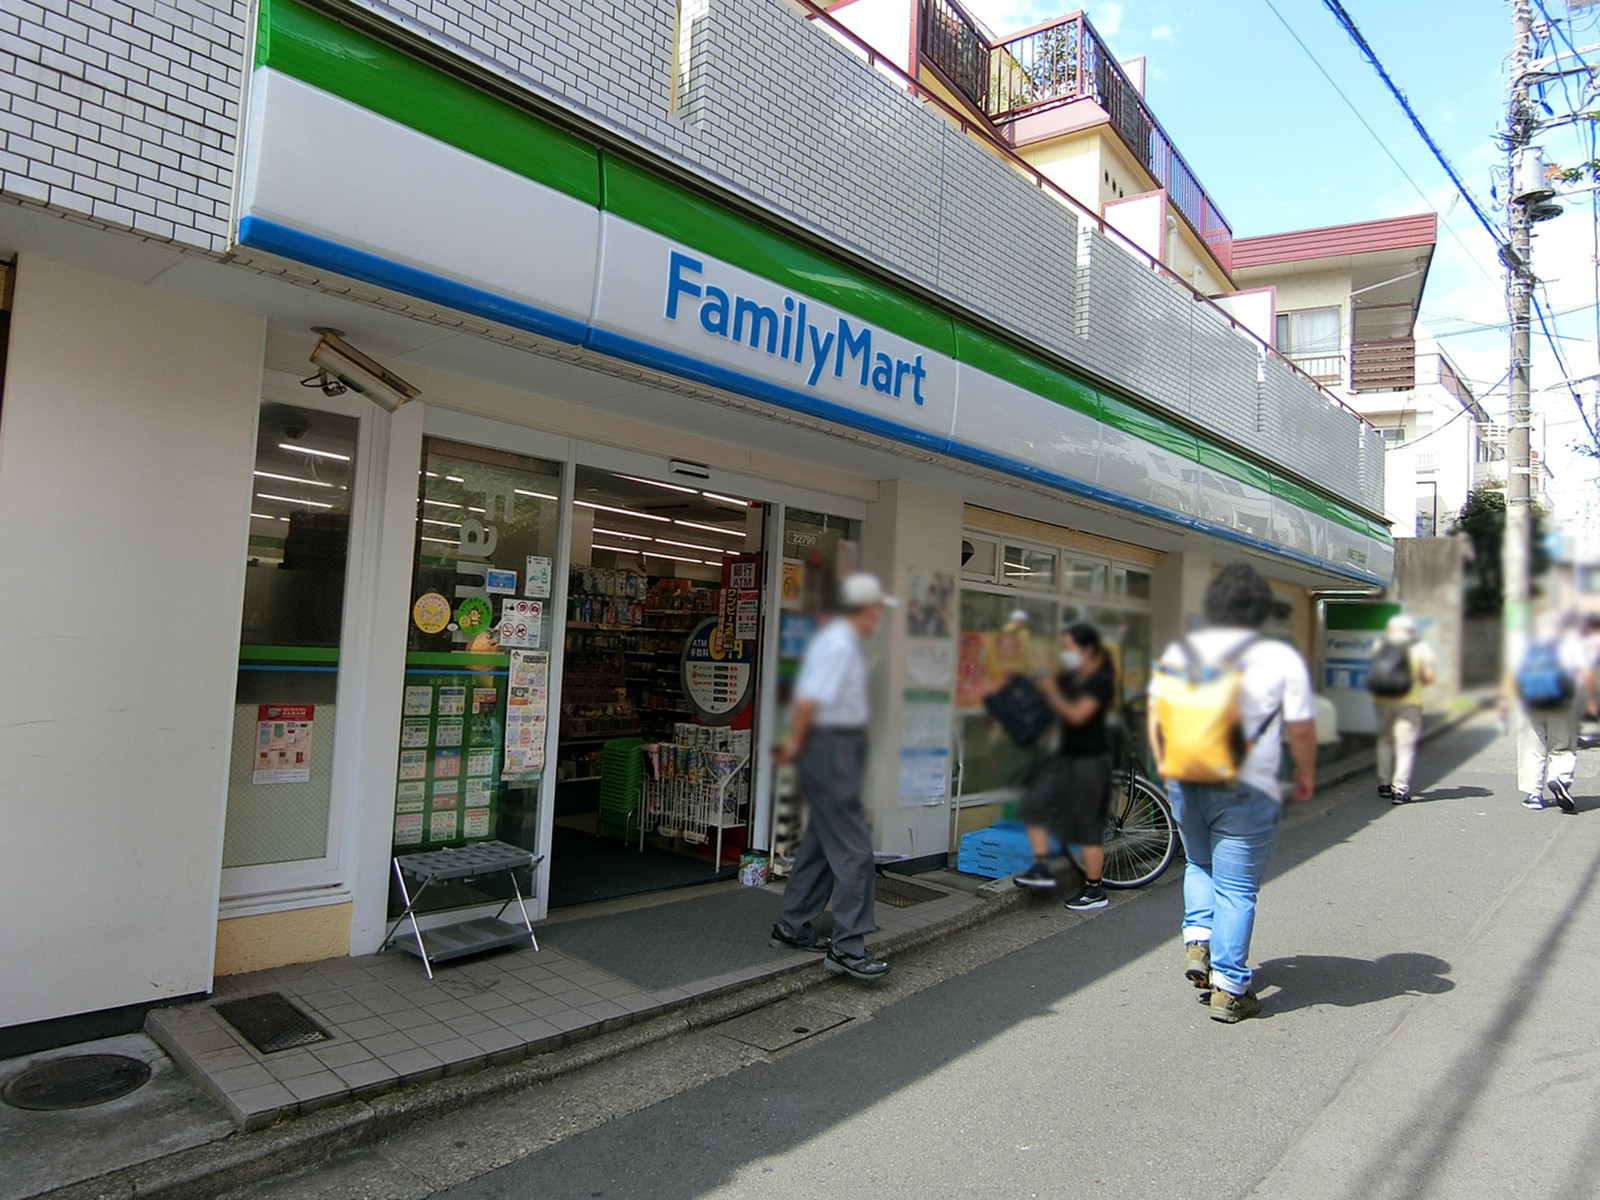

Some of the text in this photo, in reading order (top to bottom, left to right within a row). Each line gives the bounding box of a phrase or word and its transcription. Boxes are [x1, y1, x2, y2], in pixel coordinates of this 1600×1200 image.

[664, 249, 927, 407] FamilyMart
[733, 563, 753, 577] 銀行
[732, 578, 752, 587] ATM
[692, 639, 708, 648] ATM
